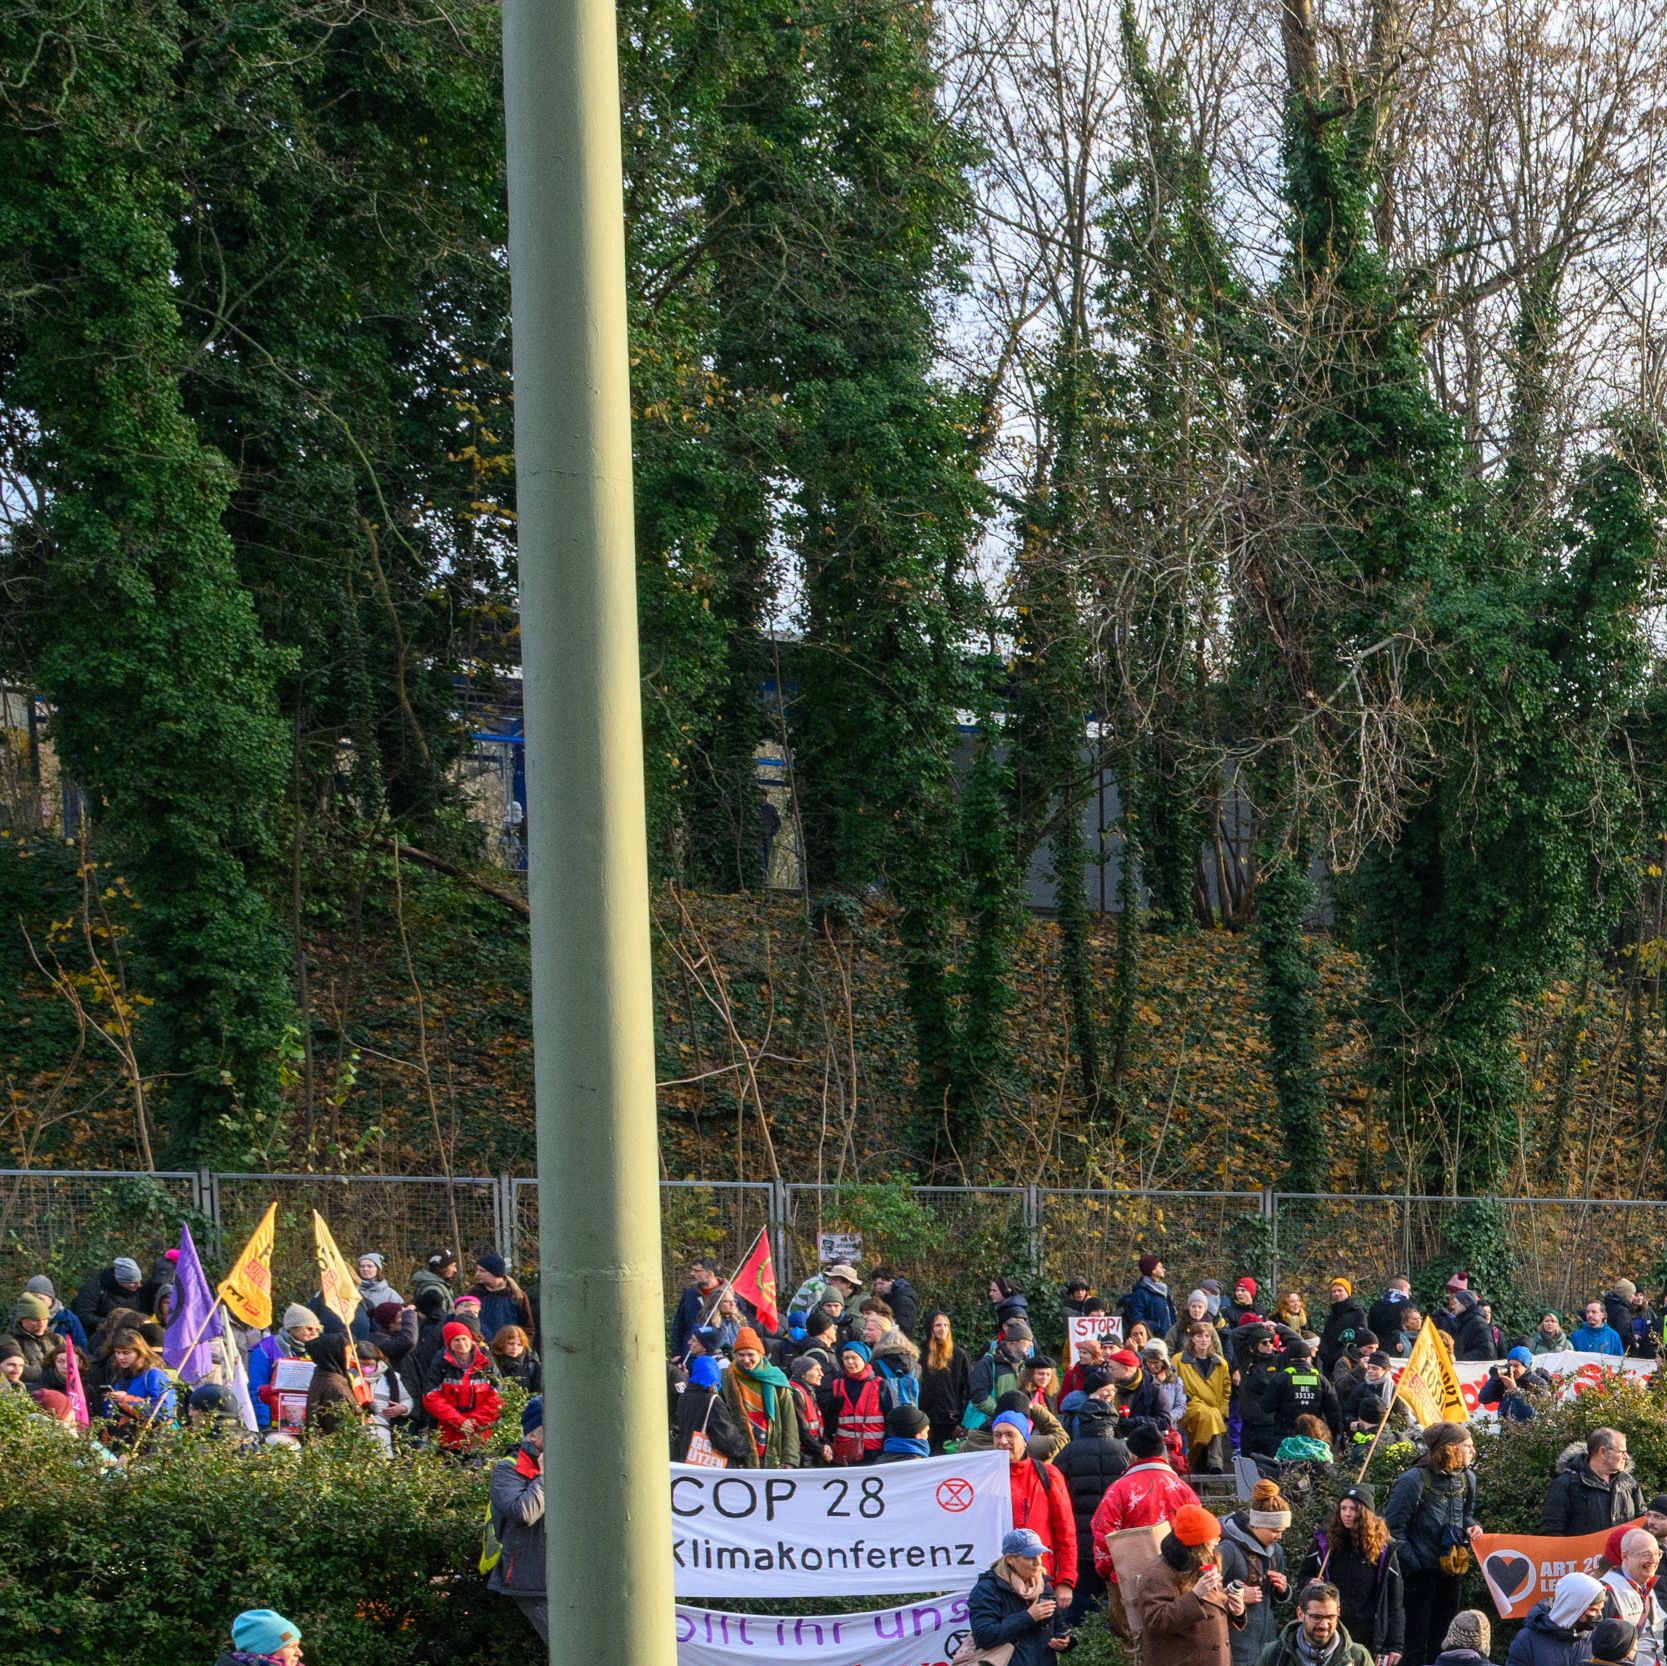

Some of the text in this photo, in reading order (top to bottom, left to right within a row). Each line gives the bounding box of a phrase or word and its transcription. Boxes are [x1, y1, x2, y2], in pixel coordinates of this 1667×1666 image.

[671, 1476, 885, 1521] COP 28
[777, 1619, 853, 1646] ihr
[874, 1598, 970, 1640] uns
